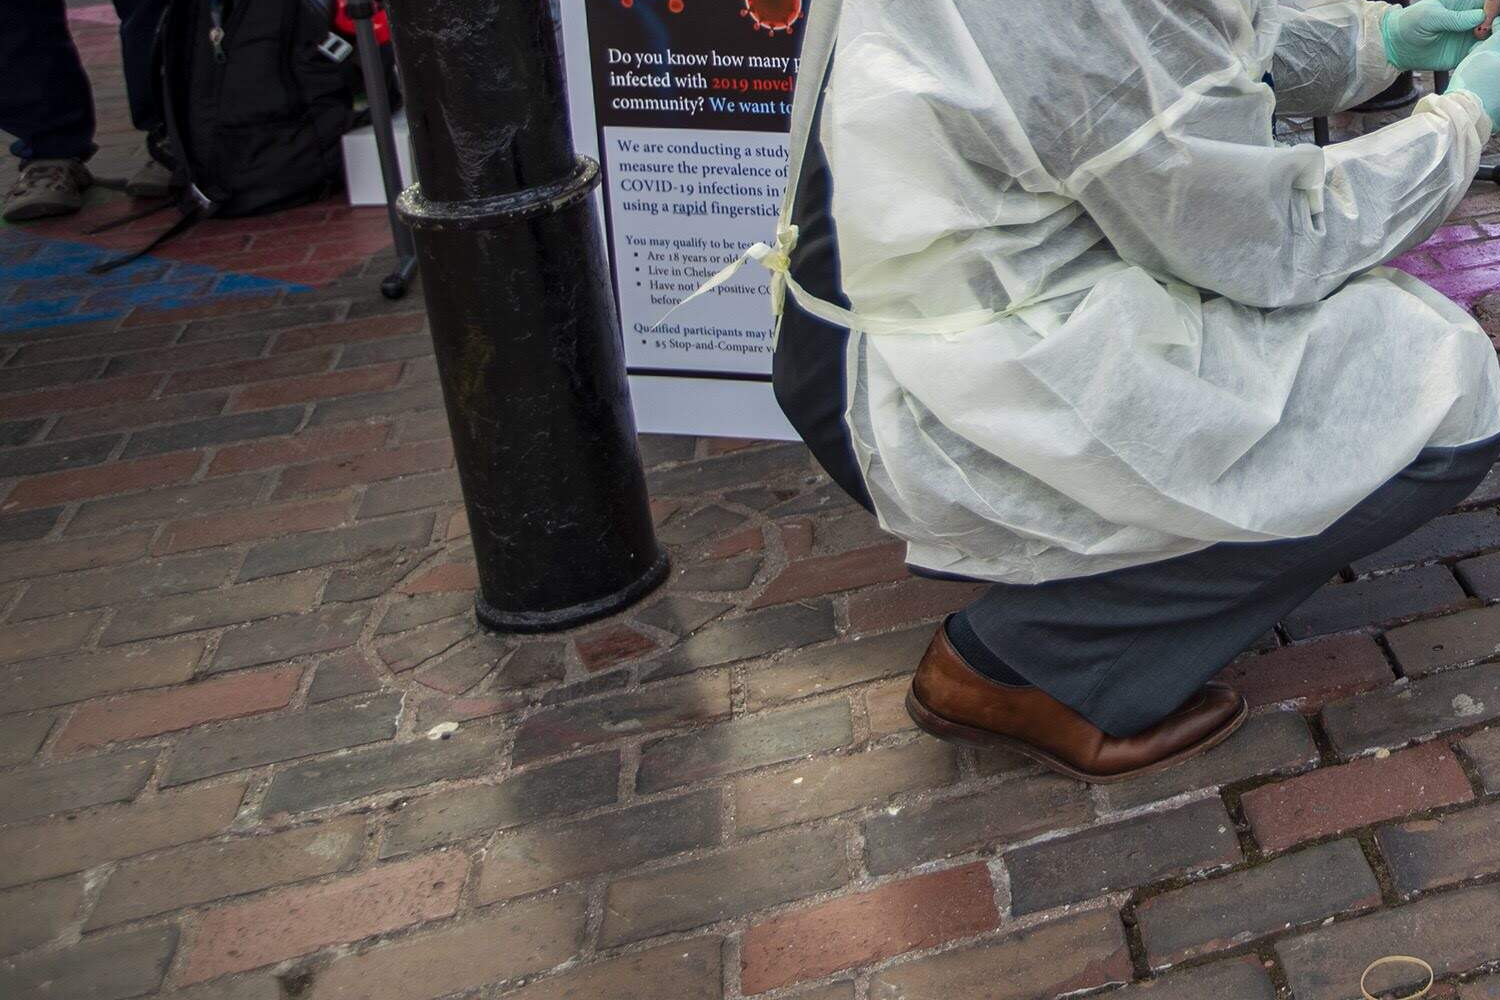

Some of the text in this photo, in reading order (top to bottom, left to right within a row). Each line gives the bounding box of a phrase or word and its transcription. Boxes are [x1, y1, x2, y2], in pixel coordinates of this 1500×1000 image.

[608, 48, 632, 64] Do
[635, 52, 663, 69] you
[667, 49, 708, 66] know
[712, 50, 743, 67] how
[748, 56, 790, 73] many
[610, 71, 794, 92] infected with 2019 novel
[612, 96, 705, 116] community?
[709, 97, 735, 112] We
[739, 99, 776, 114] want
[617, 139, 790, 162] We are conducting a study
[619, 161, 789, 178] measure the prevalence of
[620, 178, 780, 197] COVID-19 infections in
[623, 200, 781, 219] using a rapid fingerstick
[625, 235, 647, 246] You
[650, 237, 670, 250] may
[673, 237, 708, 252] qualify
[710, 240, 721, 249] to
[723, 239, 735, 249] be
[648, 251, 665, 261] Are
[668, 252, 680, 262] 18
[682, 254, 708, 265] years
[710, 255, 721, 264] or
[649, 265, 669, 276] Live
[672, 267, 682, 277] in
[650, 280, 676, 291] Have
[678, 281, 694, 291] not
[718, 284, 756, 296] positive
[683, 326, 743, 339] participants
[745, 330, 767, 340] may
[669, 338, 764, 354] Stop-and-Compare
